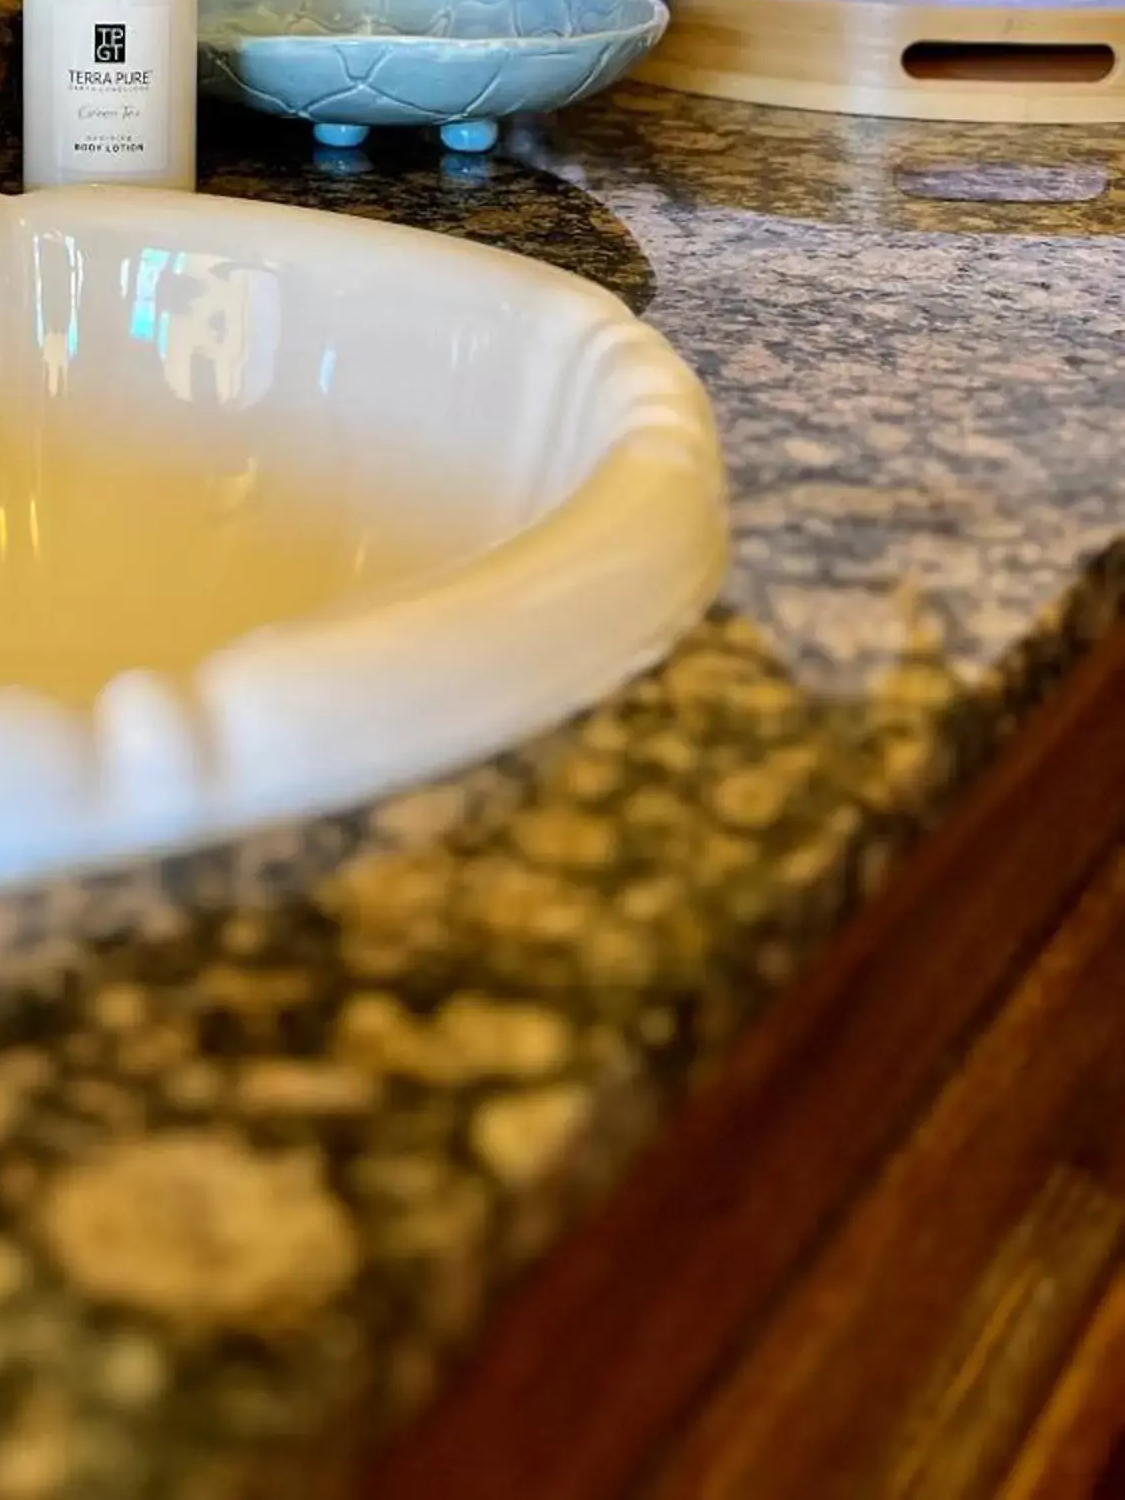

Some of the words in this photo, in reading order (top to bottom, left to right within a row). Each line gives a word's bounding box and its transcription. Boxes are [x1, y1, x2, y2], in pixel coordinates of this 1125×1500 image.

[97, 28, 124, 45] TP
[96, 45, 123, 61] GT
[68, 69, 112, 85] TERRA
[115, 71, 150, 85] PURE
[74, 143, 102, 152] BODY
[106, 143, 144, 153] LOTION
